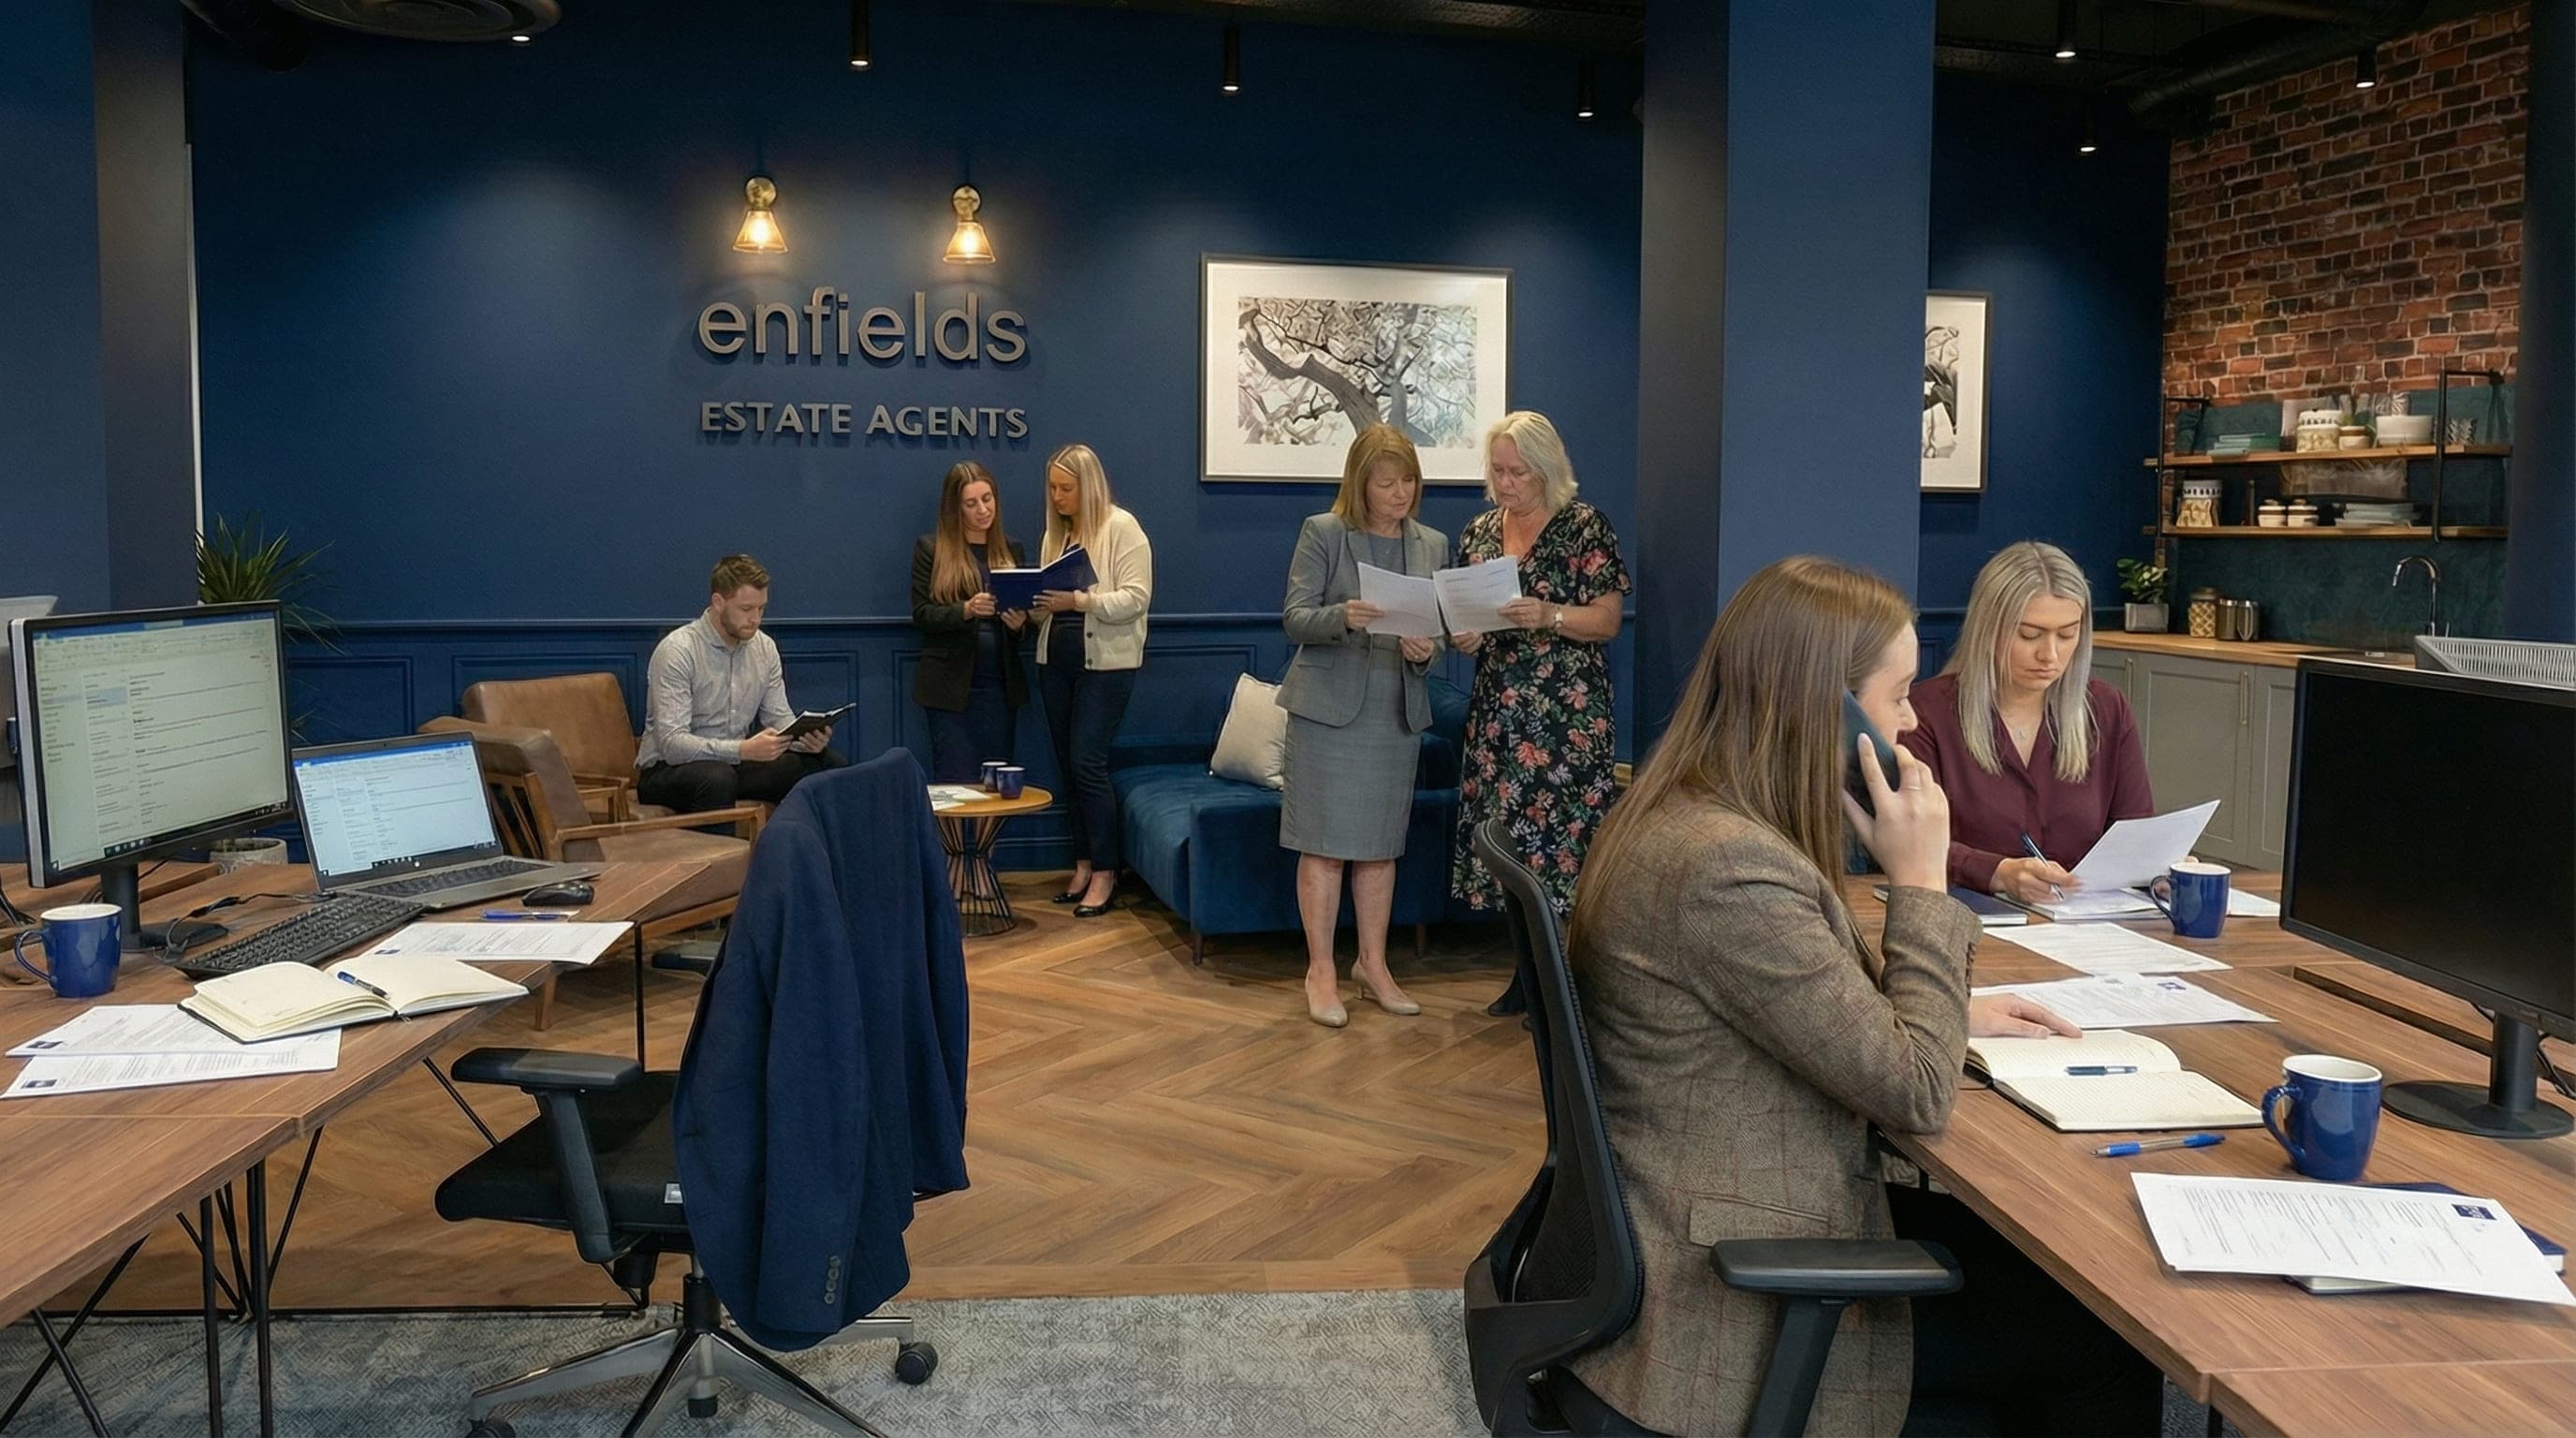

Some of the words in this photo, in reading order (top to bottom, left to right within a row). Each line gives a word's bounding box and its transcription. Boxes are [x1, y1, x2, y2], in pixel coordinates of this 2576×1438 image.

[697, 286, 1028, 362] enfields
[700, 401, 853, 433] ESTATE
[865, 404, 1028, 439] AGENTS
